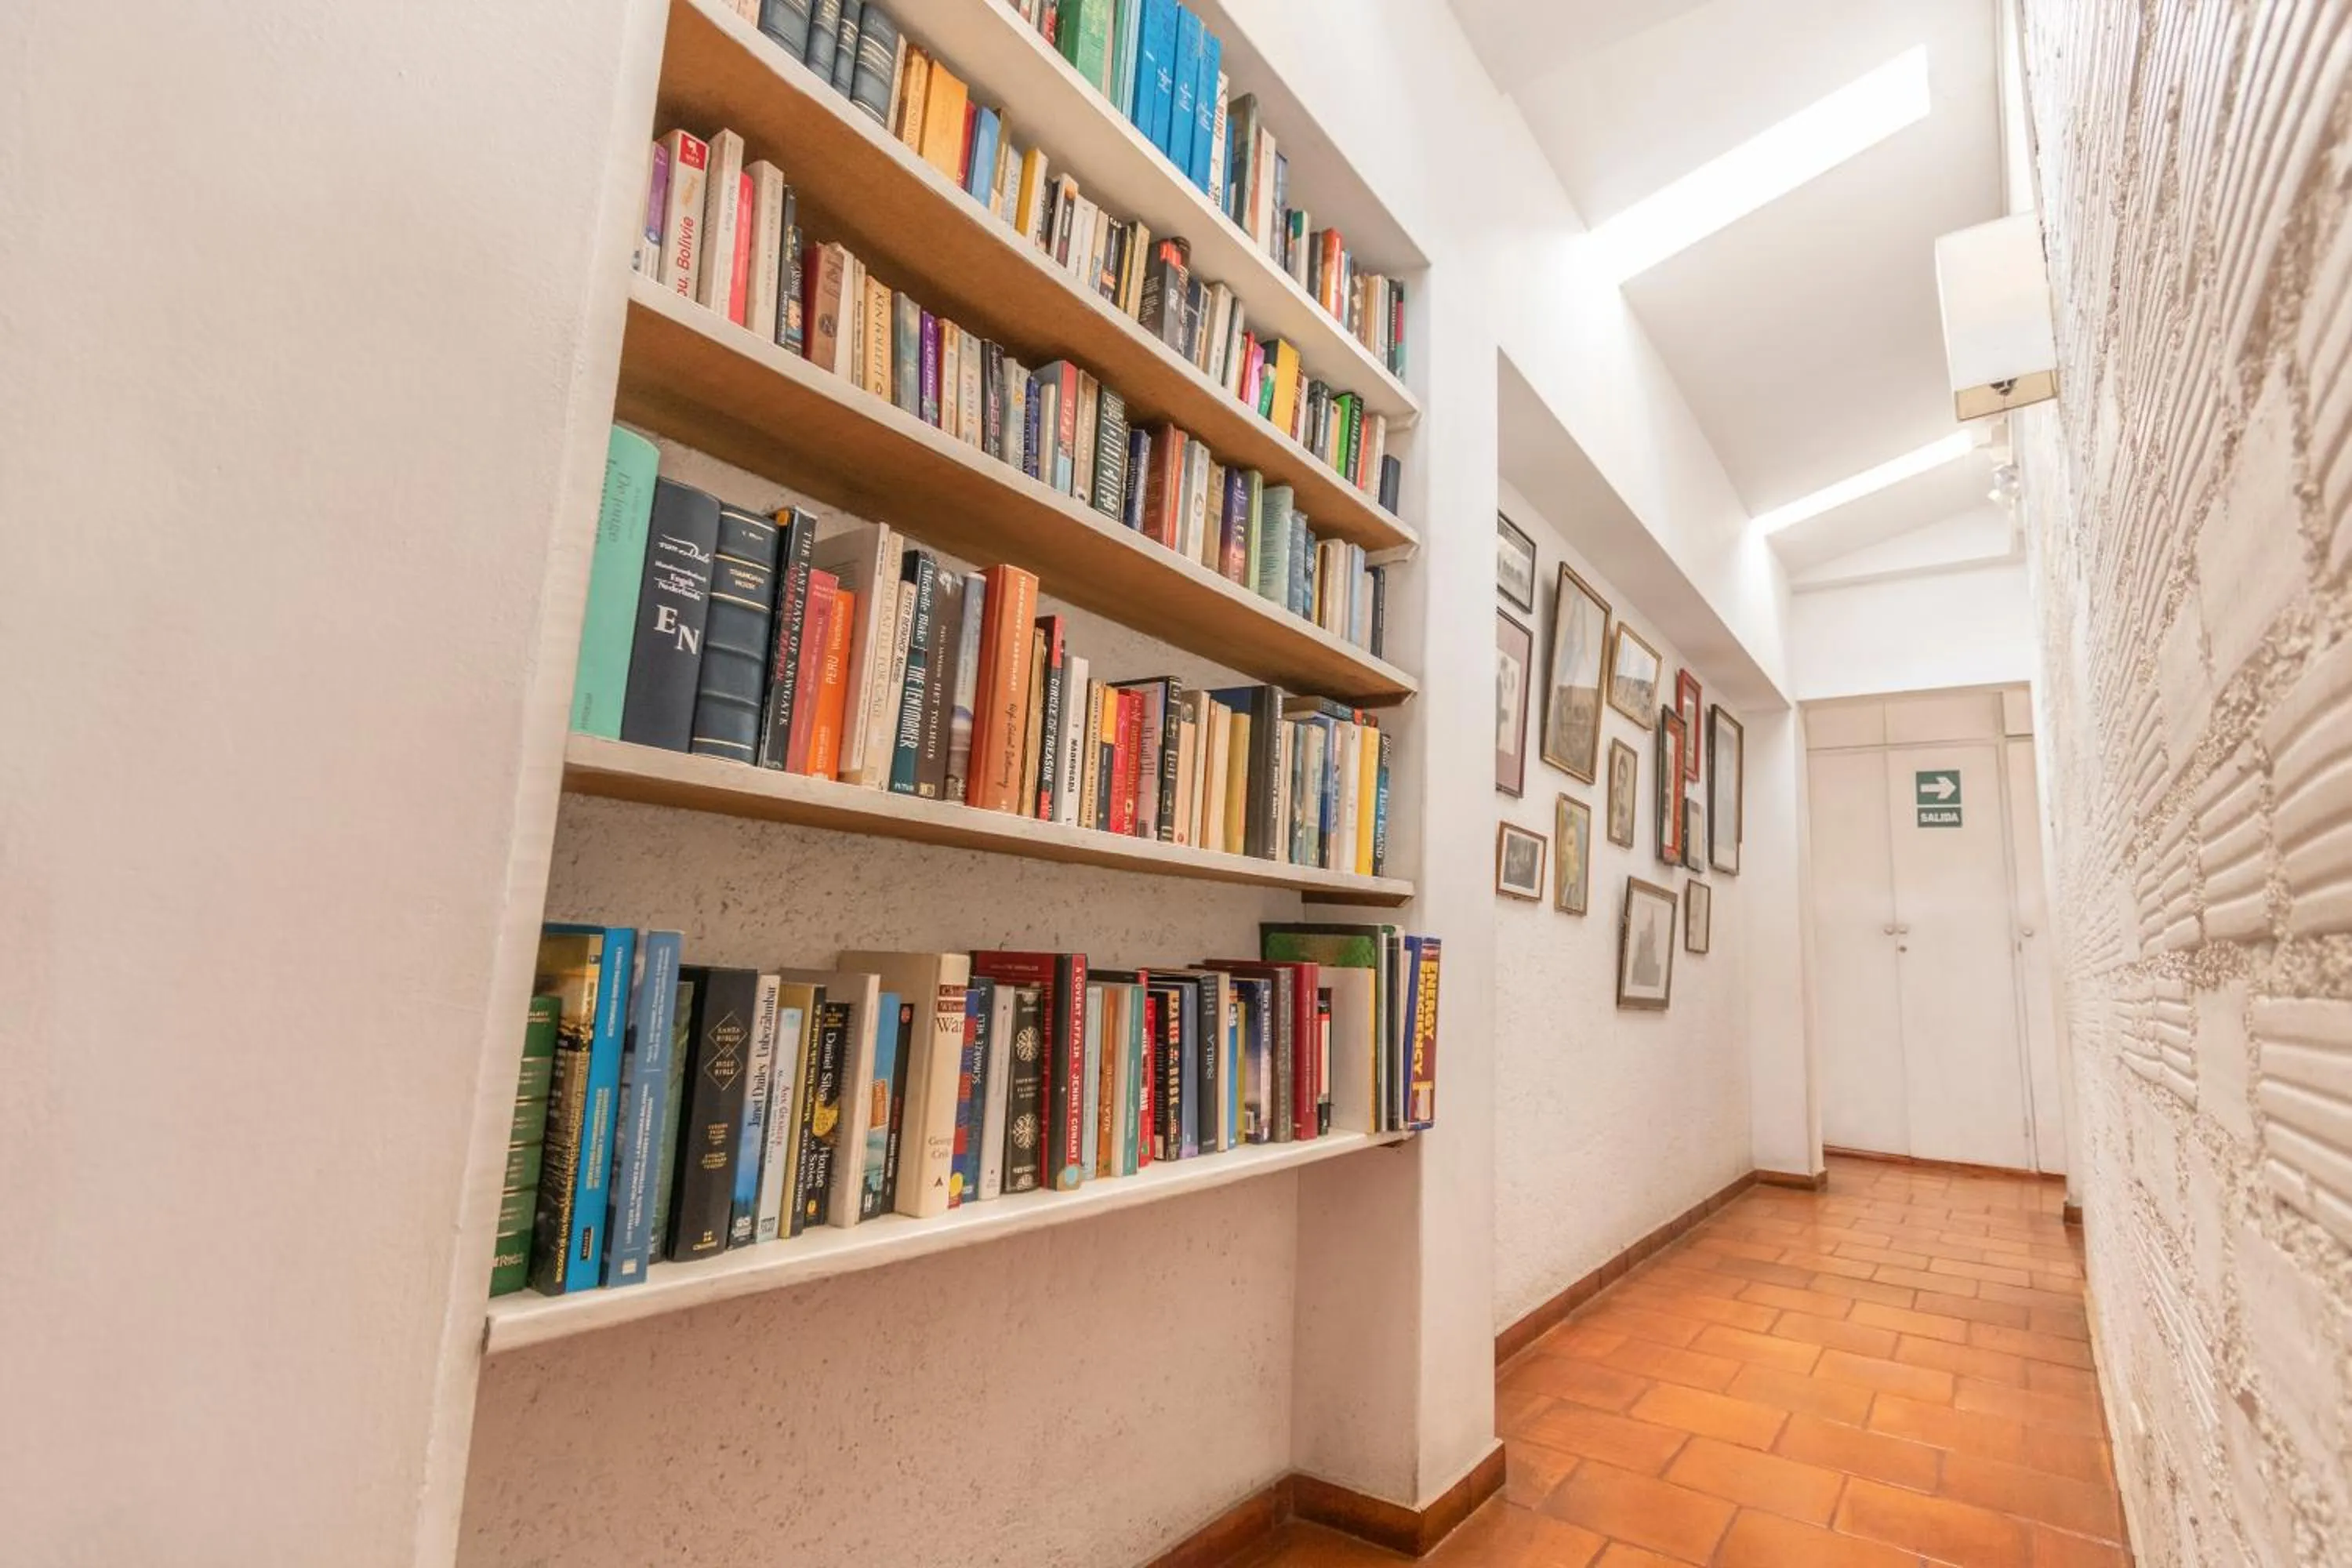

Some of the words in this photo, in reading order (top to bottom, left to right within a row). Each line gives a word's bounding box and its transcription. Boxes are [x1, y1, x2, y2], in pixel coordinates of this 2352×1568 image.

[676, 216, 695, 270] Bolivie
[875, 292, 884, 317] KEN
[800, 530, 812, 557] THE
[795, 561, 808, 594] LAST
[916, 566, 935, 612] Michelle
[789, 599, 803, 631] DAYS
[914, 612, 930, 642] Blake
[787, 636, 798, 653] OF
[823, 654, 840, 684] PERU
[906, 664, 927, 685] THE
[777, 660, 795, 726] NEWGATE
[931, 681, 942, 705] HET
[1047, 677, 1060, 715] CIRCLE
[898, 685, 926, 750] TENTMAKER
[925, 709, 939, 760] TOLHUIS
[1041, 734, 1056, 782] TREASON
[1920, 812, 1959, 822] SALIDA
[1374, 819, 1386, 858] ISLAND
[1073, 976, 1082, 1015] COVERT
[1420, 960, 1441, 1040] ENERGY
[752, 985, 779, 1058] Unbezähmbar
[936, 1017, 963, 1033] War
[975, 1012, 985, 1033] WELT
[808, 1048, 817, 1065] ich
[820, 1031, 837, 1070] Daniel
[971, 1040, 984, 1084] SCHWARZE
[750, 1062, 768, 1098] Dailey
[815, 1071, 833, 1102] Silva
[746, 1098, 764, 1128] Janet
[803, 1086, 815, 1122] Morgen
[1069, 1116, 1078, 1158] CONANT
[803, 1152, 819, 1189] Spies
[811, 1145, 831, 1189] House
